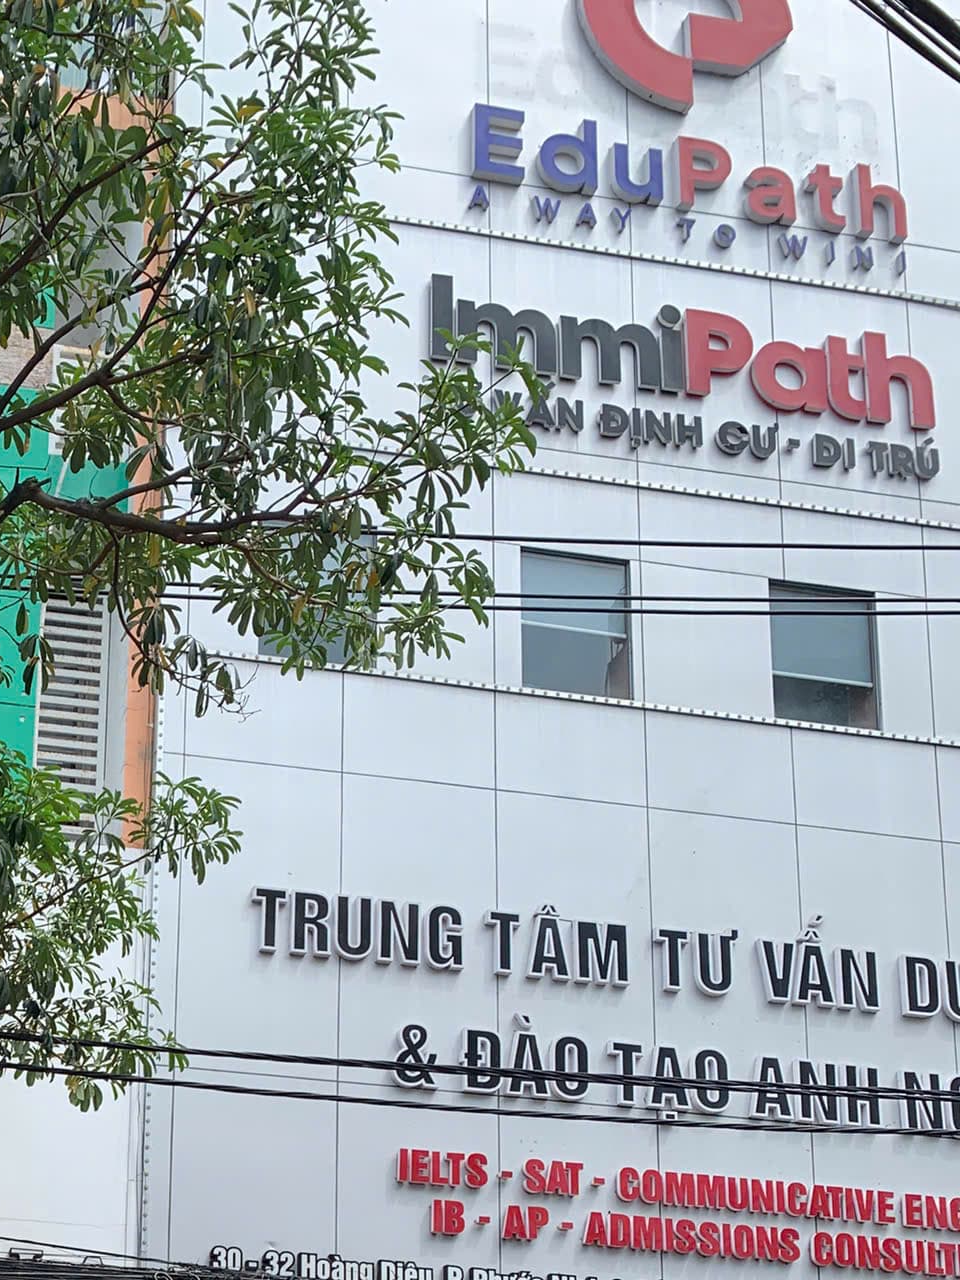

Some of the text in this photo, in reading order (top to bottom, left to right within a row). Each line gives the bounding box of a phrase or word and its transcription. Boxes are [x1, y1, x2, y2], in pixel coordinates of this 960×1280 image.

[471, 103, 907, 244] EduPath
[468, 185, 489, 211] A
[528, 194, 631, 233] WAY
[677, 217, 736, 248] TO
[430, 274, 936, 430] ImmiPath
[597, 403, 703, 450] ĐỊNH
[714, 420, 779, 459] CƯ
[867, 437, 939, 480] TRÚ
[251, 886, 464, 970] TRUNG
[482, 904, 630, 988] TÂM
[653, 929, 739, 997] TƯ
[755, 915, 880, 1013] VẤN
[391, 1024, 437, 1090] &
[460, 1013, 589, 1101] ĐÀO
[606, 1041, 730, 1121] TẠO
[749, 1056, 880, 1126] ANH
[397, 1148, 489, 1188] IELTS
[522, 1159, 584, 1197] SAT
[616, 1167, 896, 1225] COMMUNICATIVE
[210, 1246, 242, 1273] 30
[263, 1250, 295, 1277] 32
[429, 1199, 465, 1236] IB
[501, 1205, 549, 1241] AP
[582, 1211, 801, 1263] ADMISSIONS
